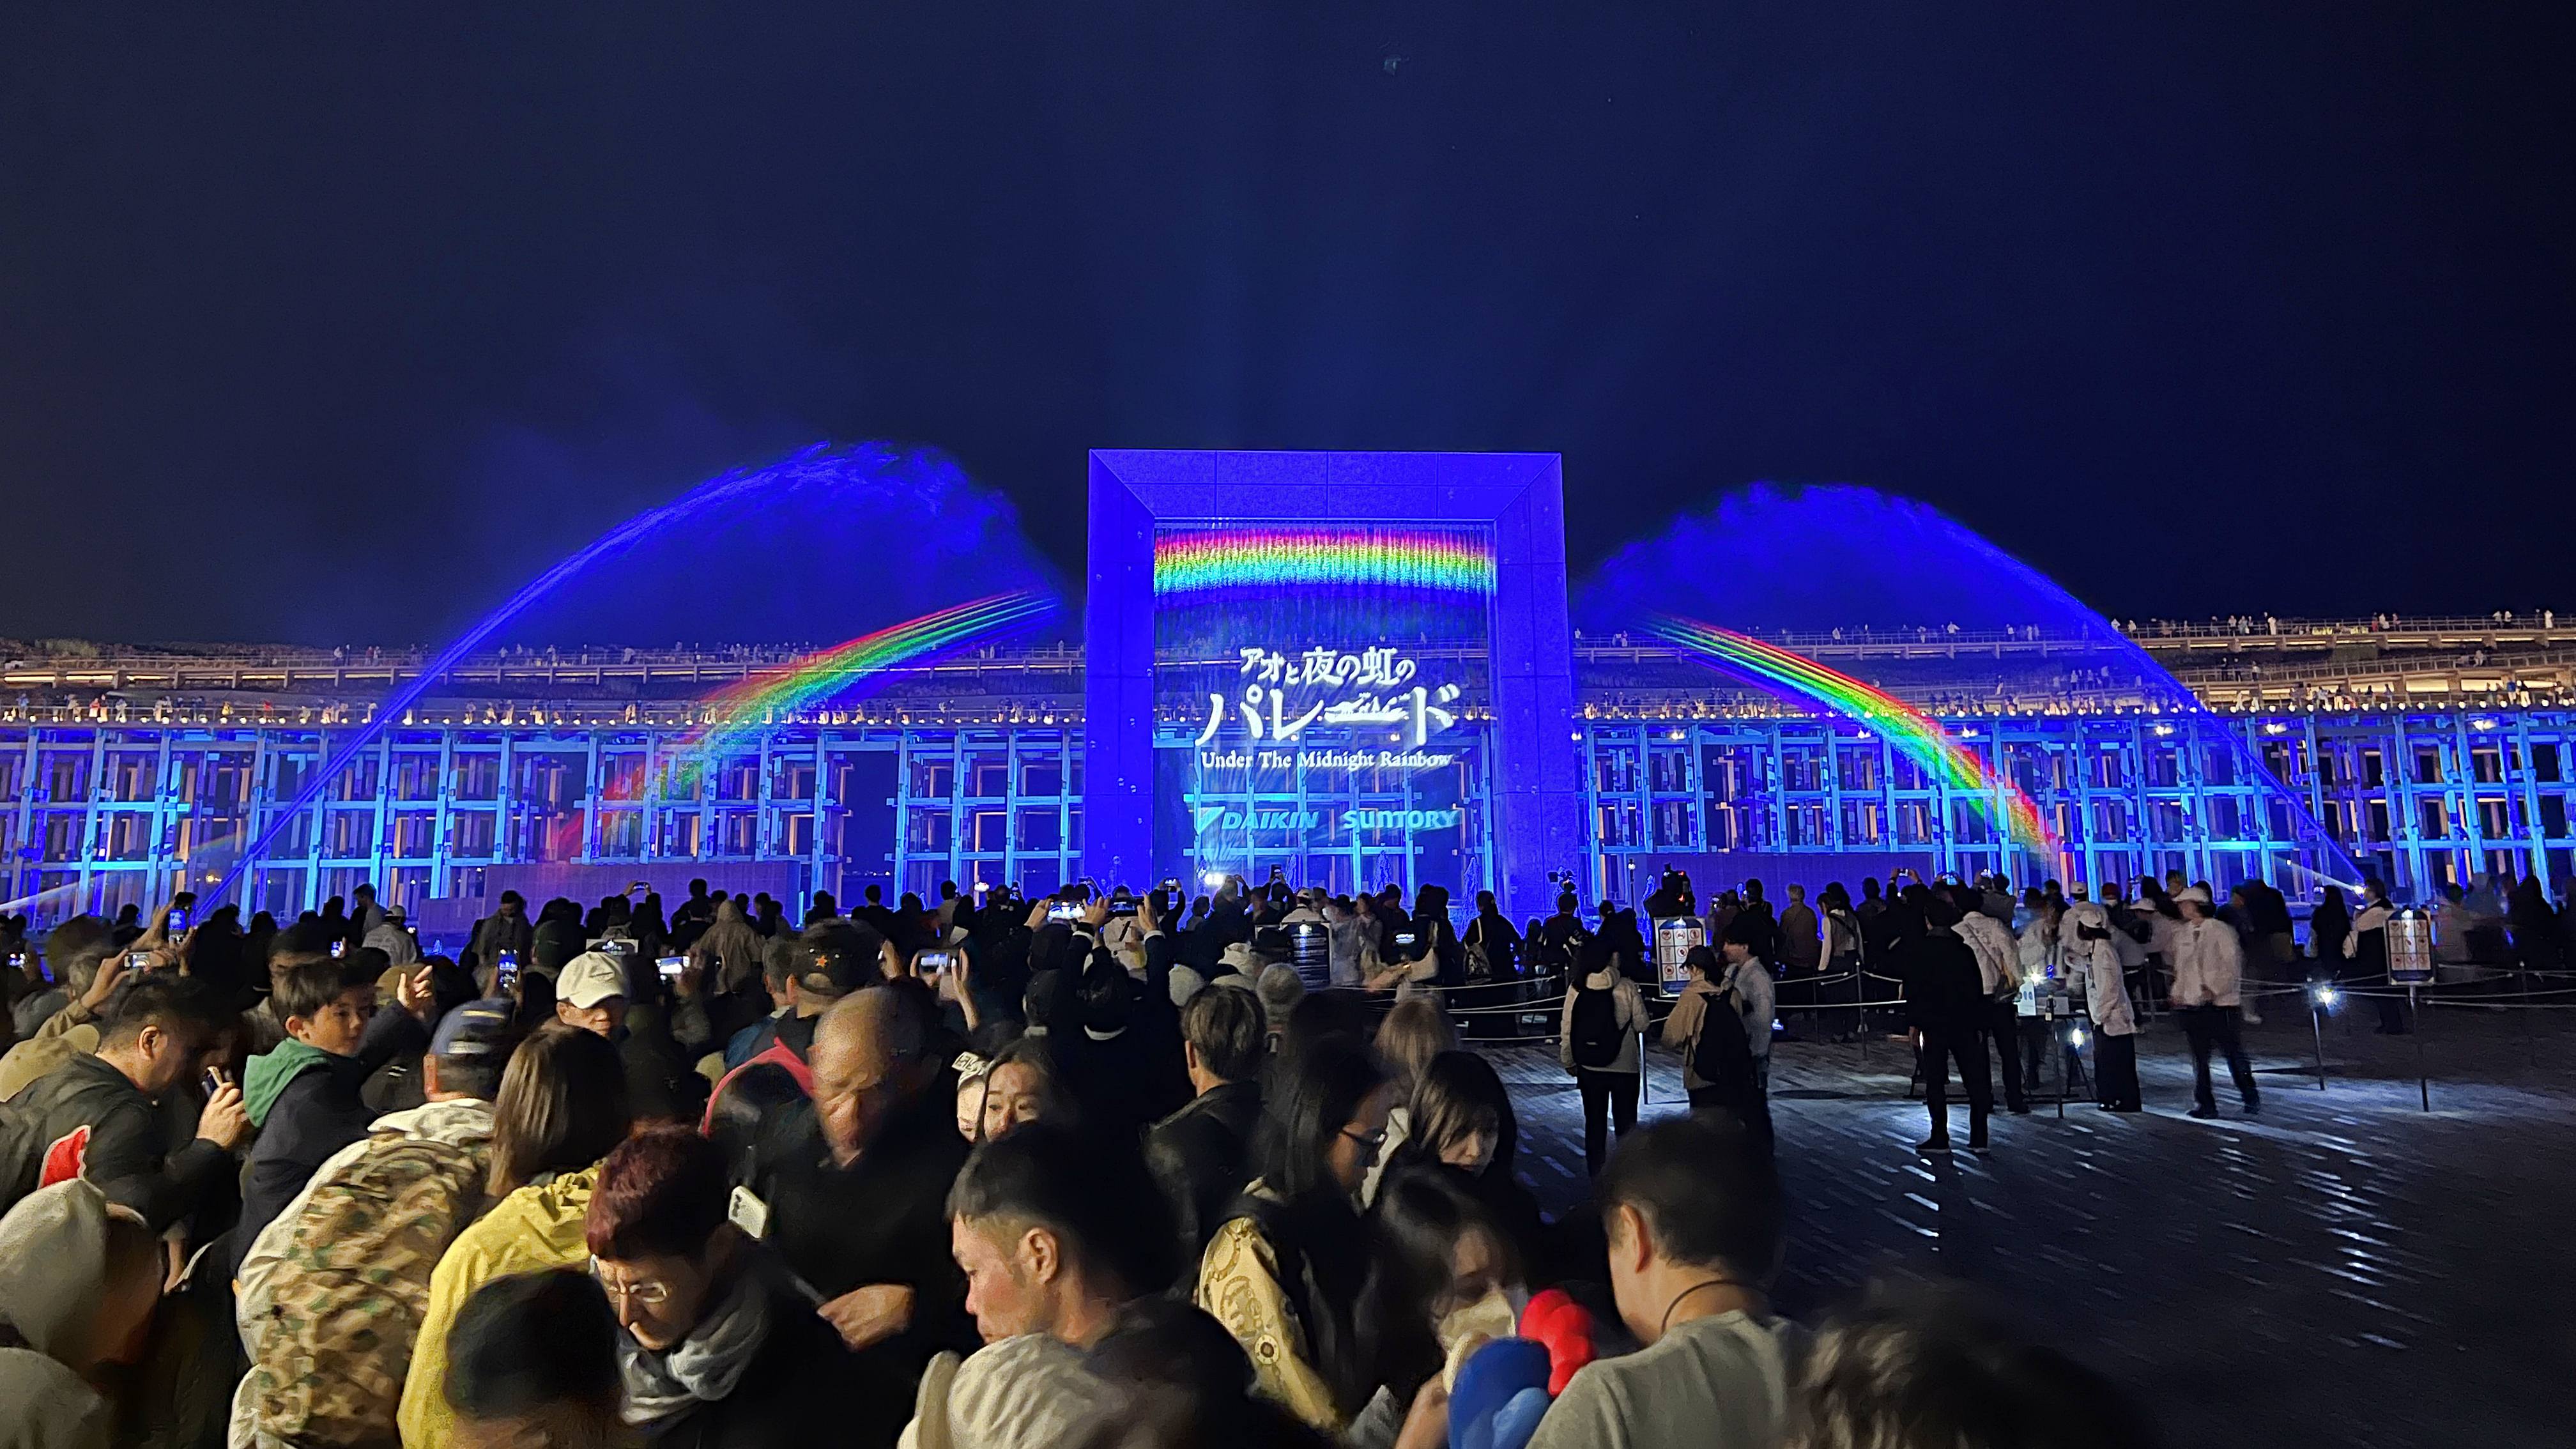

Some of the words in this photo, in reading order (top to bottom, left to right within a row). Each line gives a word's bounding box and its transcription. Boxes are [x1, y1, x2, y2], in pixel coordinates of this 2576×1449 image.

[1239, 645, 1416, 685] アオと夜の虹の
[1195, 683, 1460, 746] パレード
[1200, 749, 1253, 768] Under
[1258, 749, 1292, 768] The
[1299, 749, 1375, 770] Midnight
[1379, 749, 1453, 767] Rainbow
[1221, 811, 1319, 829] DAIKIN
[1343, 809, 1458, 829] SUNTORY
